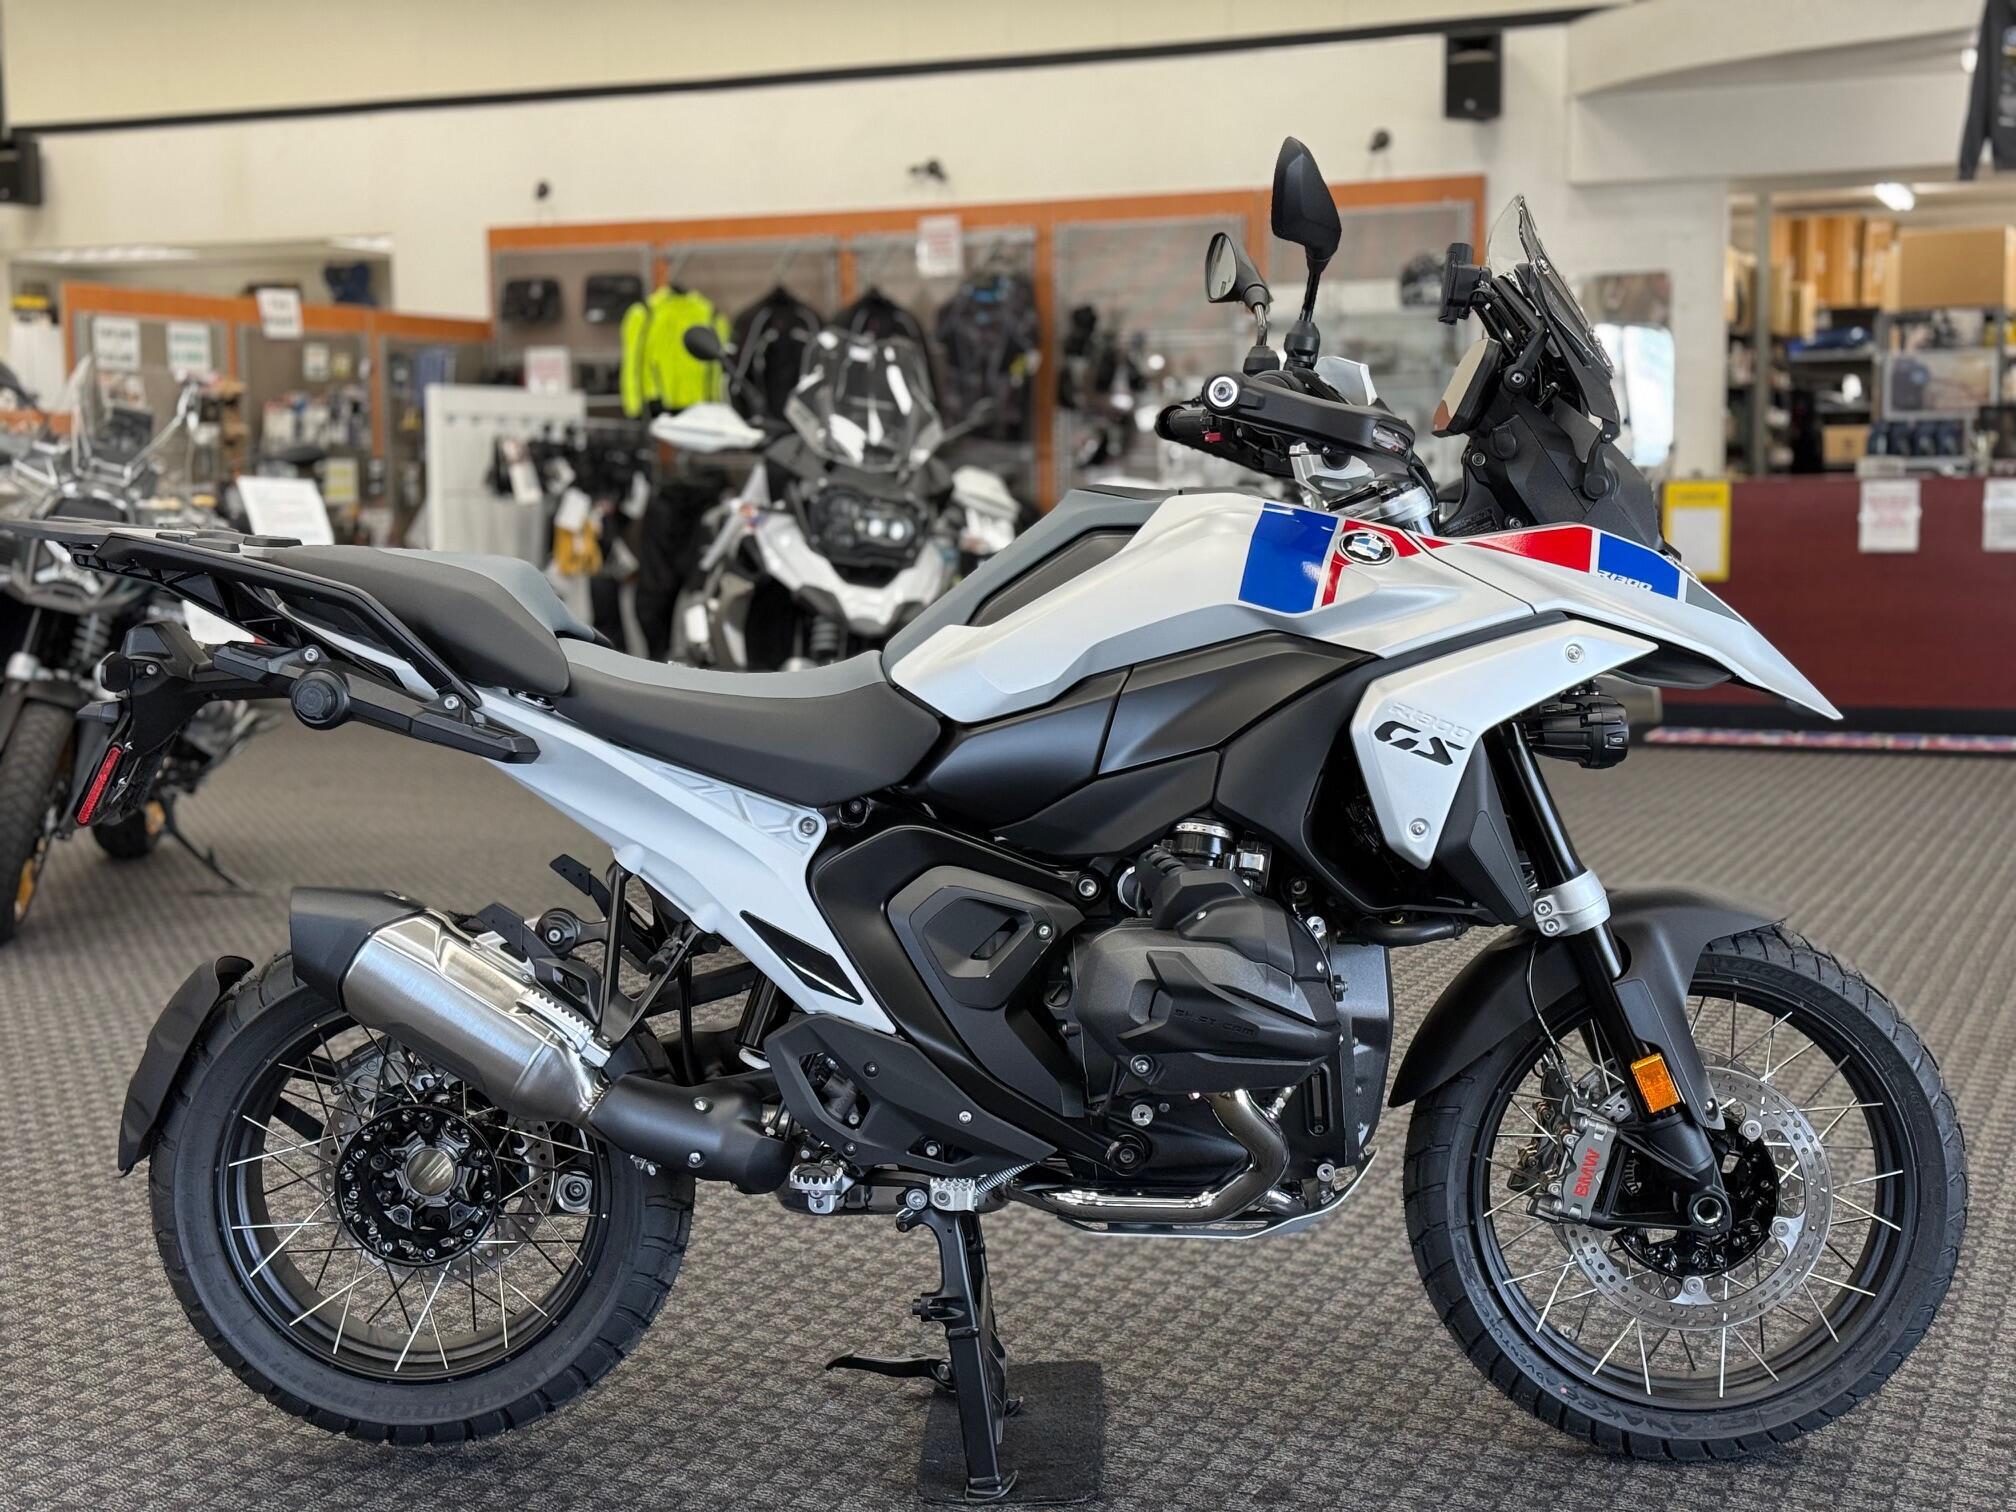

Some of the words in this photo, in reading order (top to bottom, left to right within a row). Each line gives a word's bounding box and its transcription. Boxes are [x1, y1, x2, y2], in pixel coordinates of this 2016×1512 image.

[1374, 721, 1466, 766] GS
[1174, 1008, 1217, 1028] SHFT
[1574, 1146, 1600, 1197] BMW
[1481, 1306, 1558, 1388] ADVENTURE
[1561, 1384, 1693, 1433] ANAKEE
